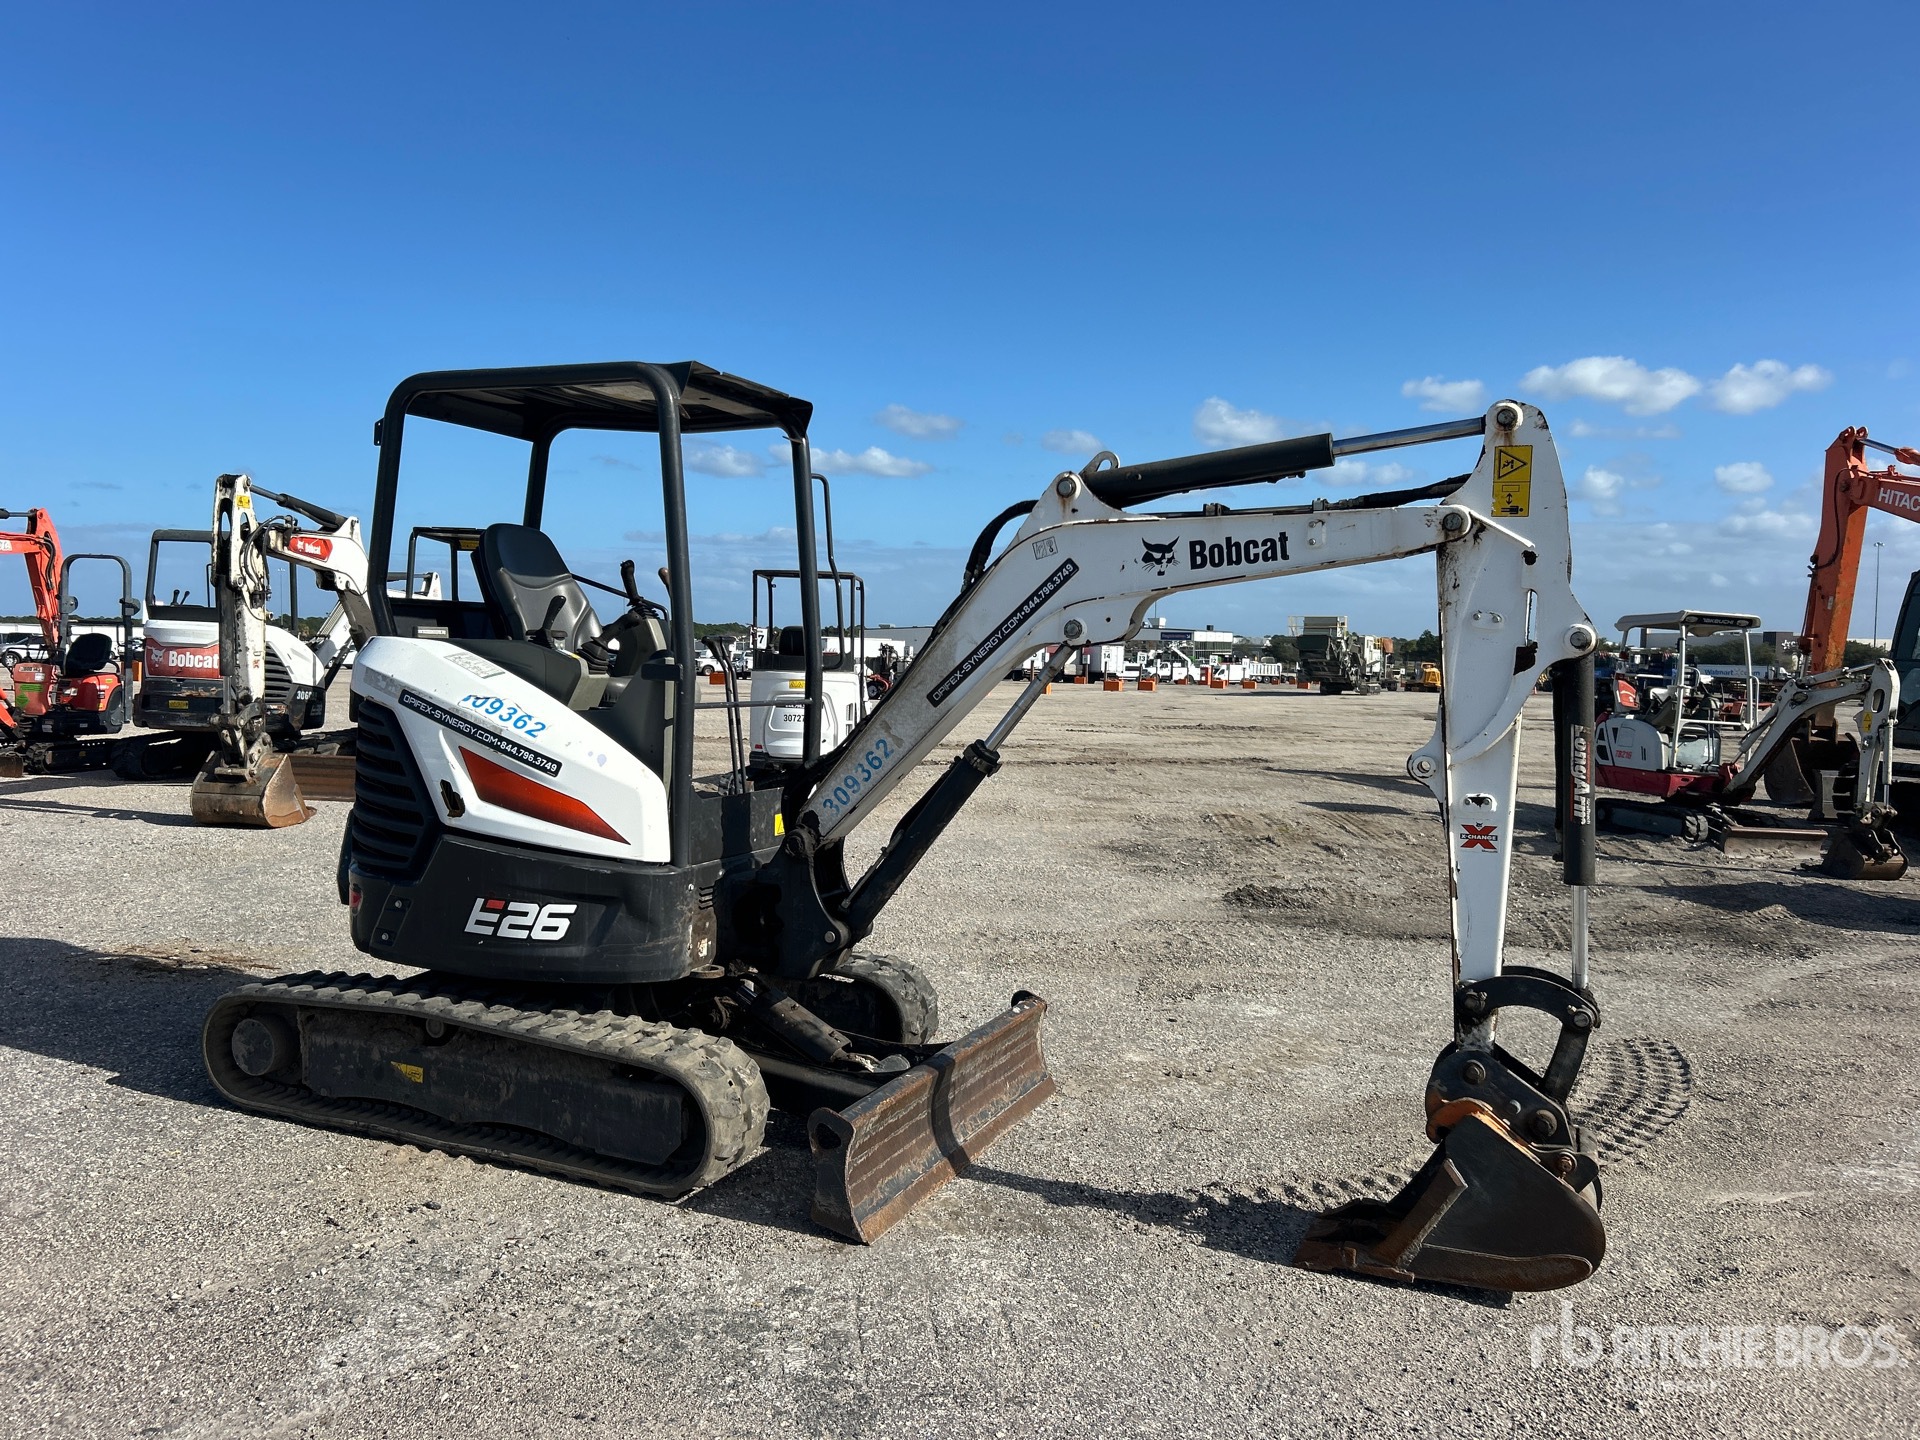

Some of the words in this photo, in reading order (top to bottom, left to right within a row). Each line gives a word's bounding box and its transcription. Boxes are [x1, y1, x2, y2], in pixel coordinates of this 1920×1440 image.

[1878, 487, 1920, 511] HITAC
[1189, 531, 1289, 570] Bobcat
[168, 651, 219, 669] Bobcat
[1704, 668, 1734, 676] Walmart
[823, 739, 894, 817] 309362
[464, 897, 578, 940] E26
